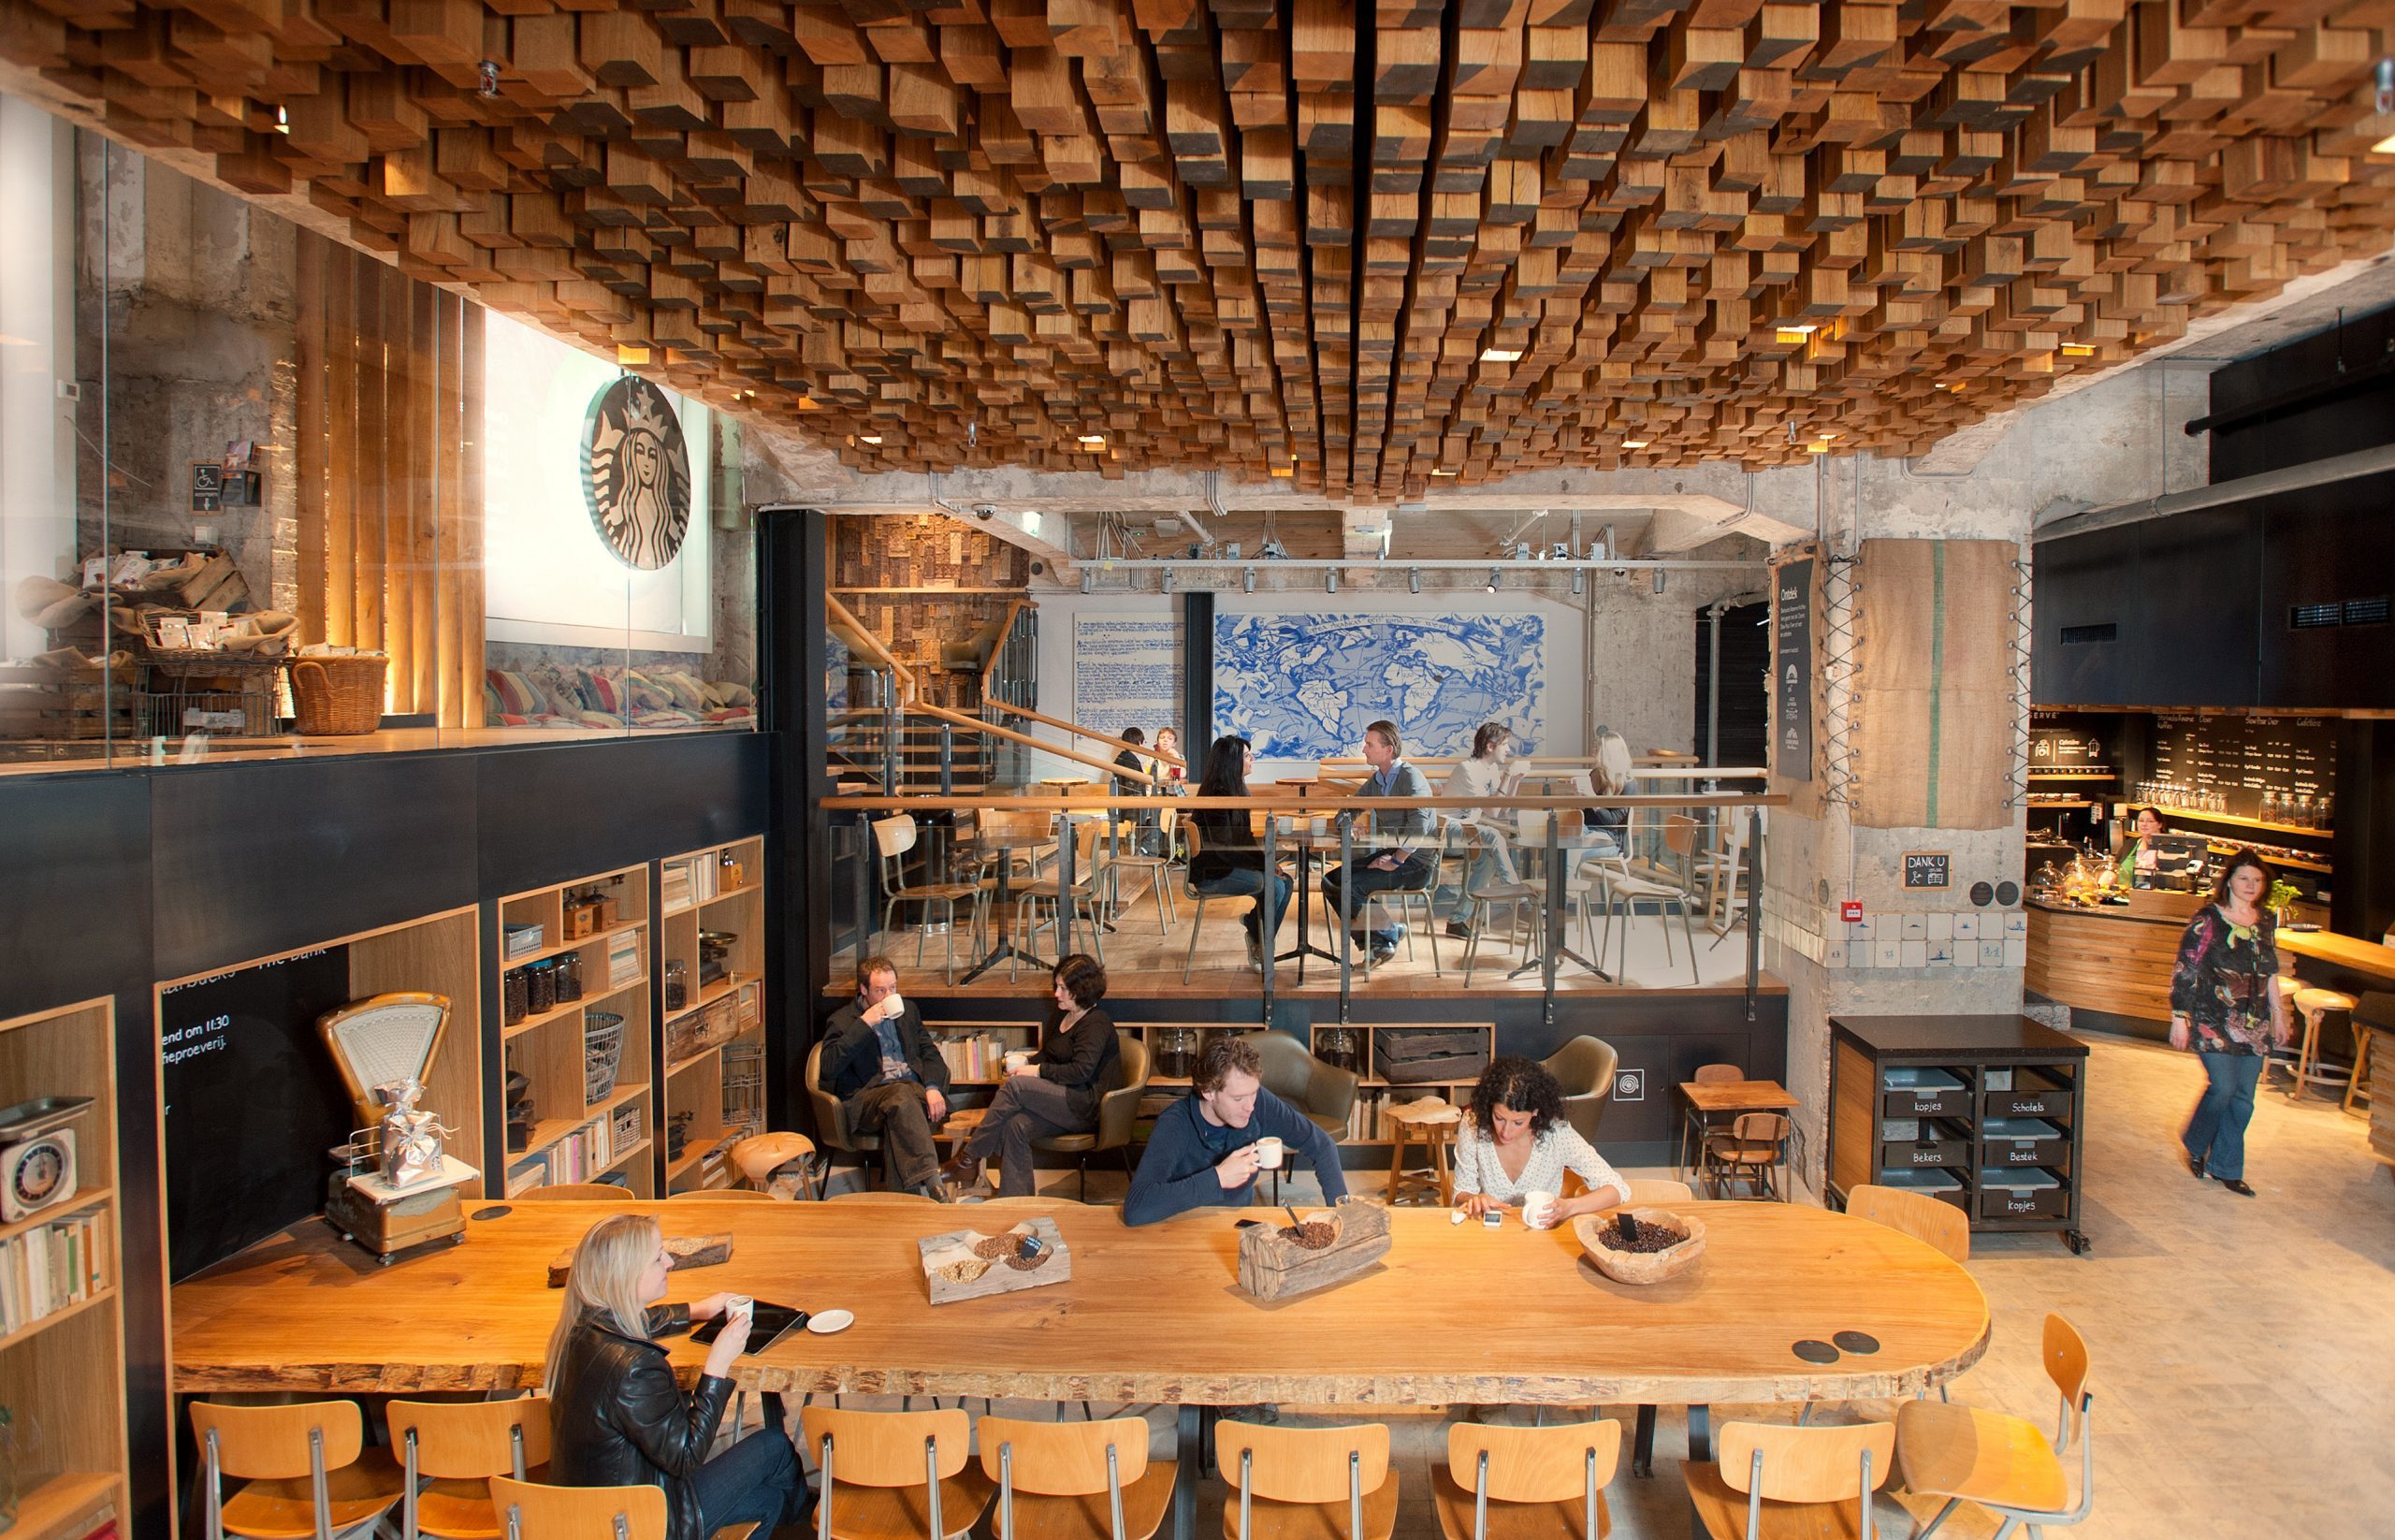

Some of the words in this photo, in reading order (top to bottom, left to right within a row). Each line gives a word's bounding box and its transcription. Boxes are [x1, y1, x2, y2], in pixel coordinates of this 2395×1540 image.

[1908, 856, 1935, 868] DANK
[1937, 856, 1945, 867] U
[185, 1025, 203, 1039] om
[2011, 1101, 2045, 1112] Schotels
[1913, 1152, 1942, 1163] Bekers
[2010, 1151, 2039, 1162] Bestek
